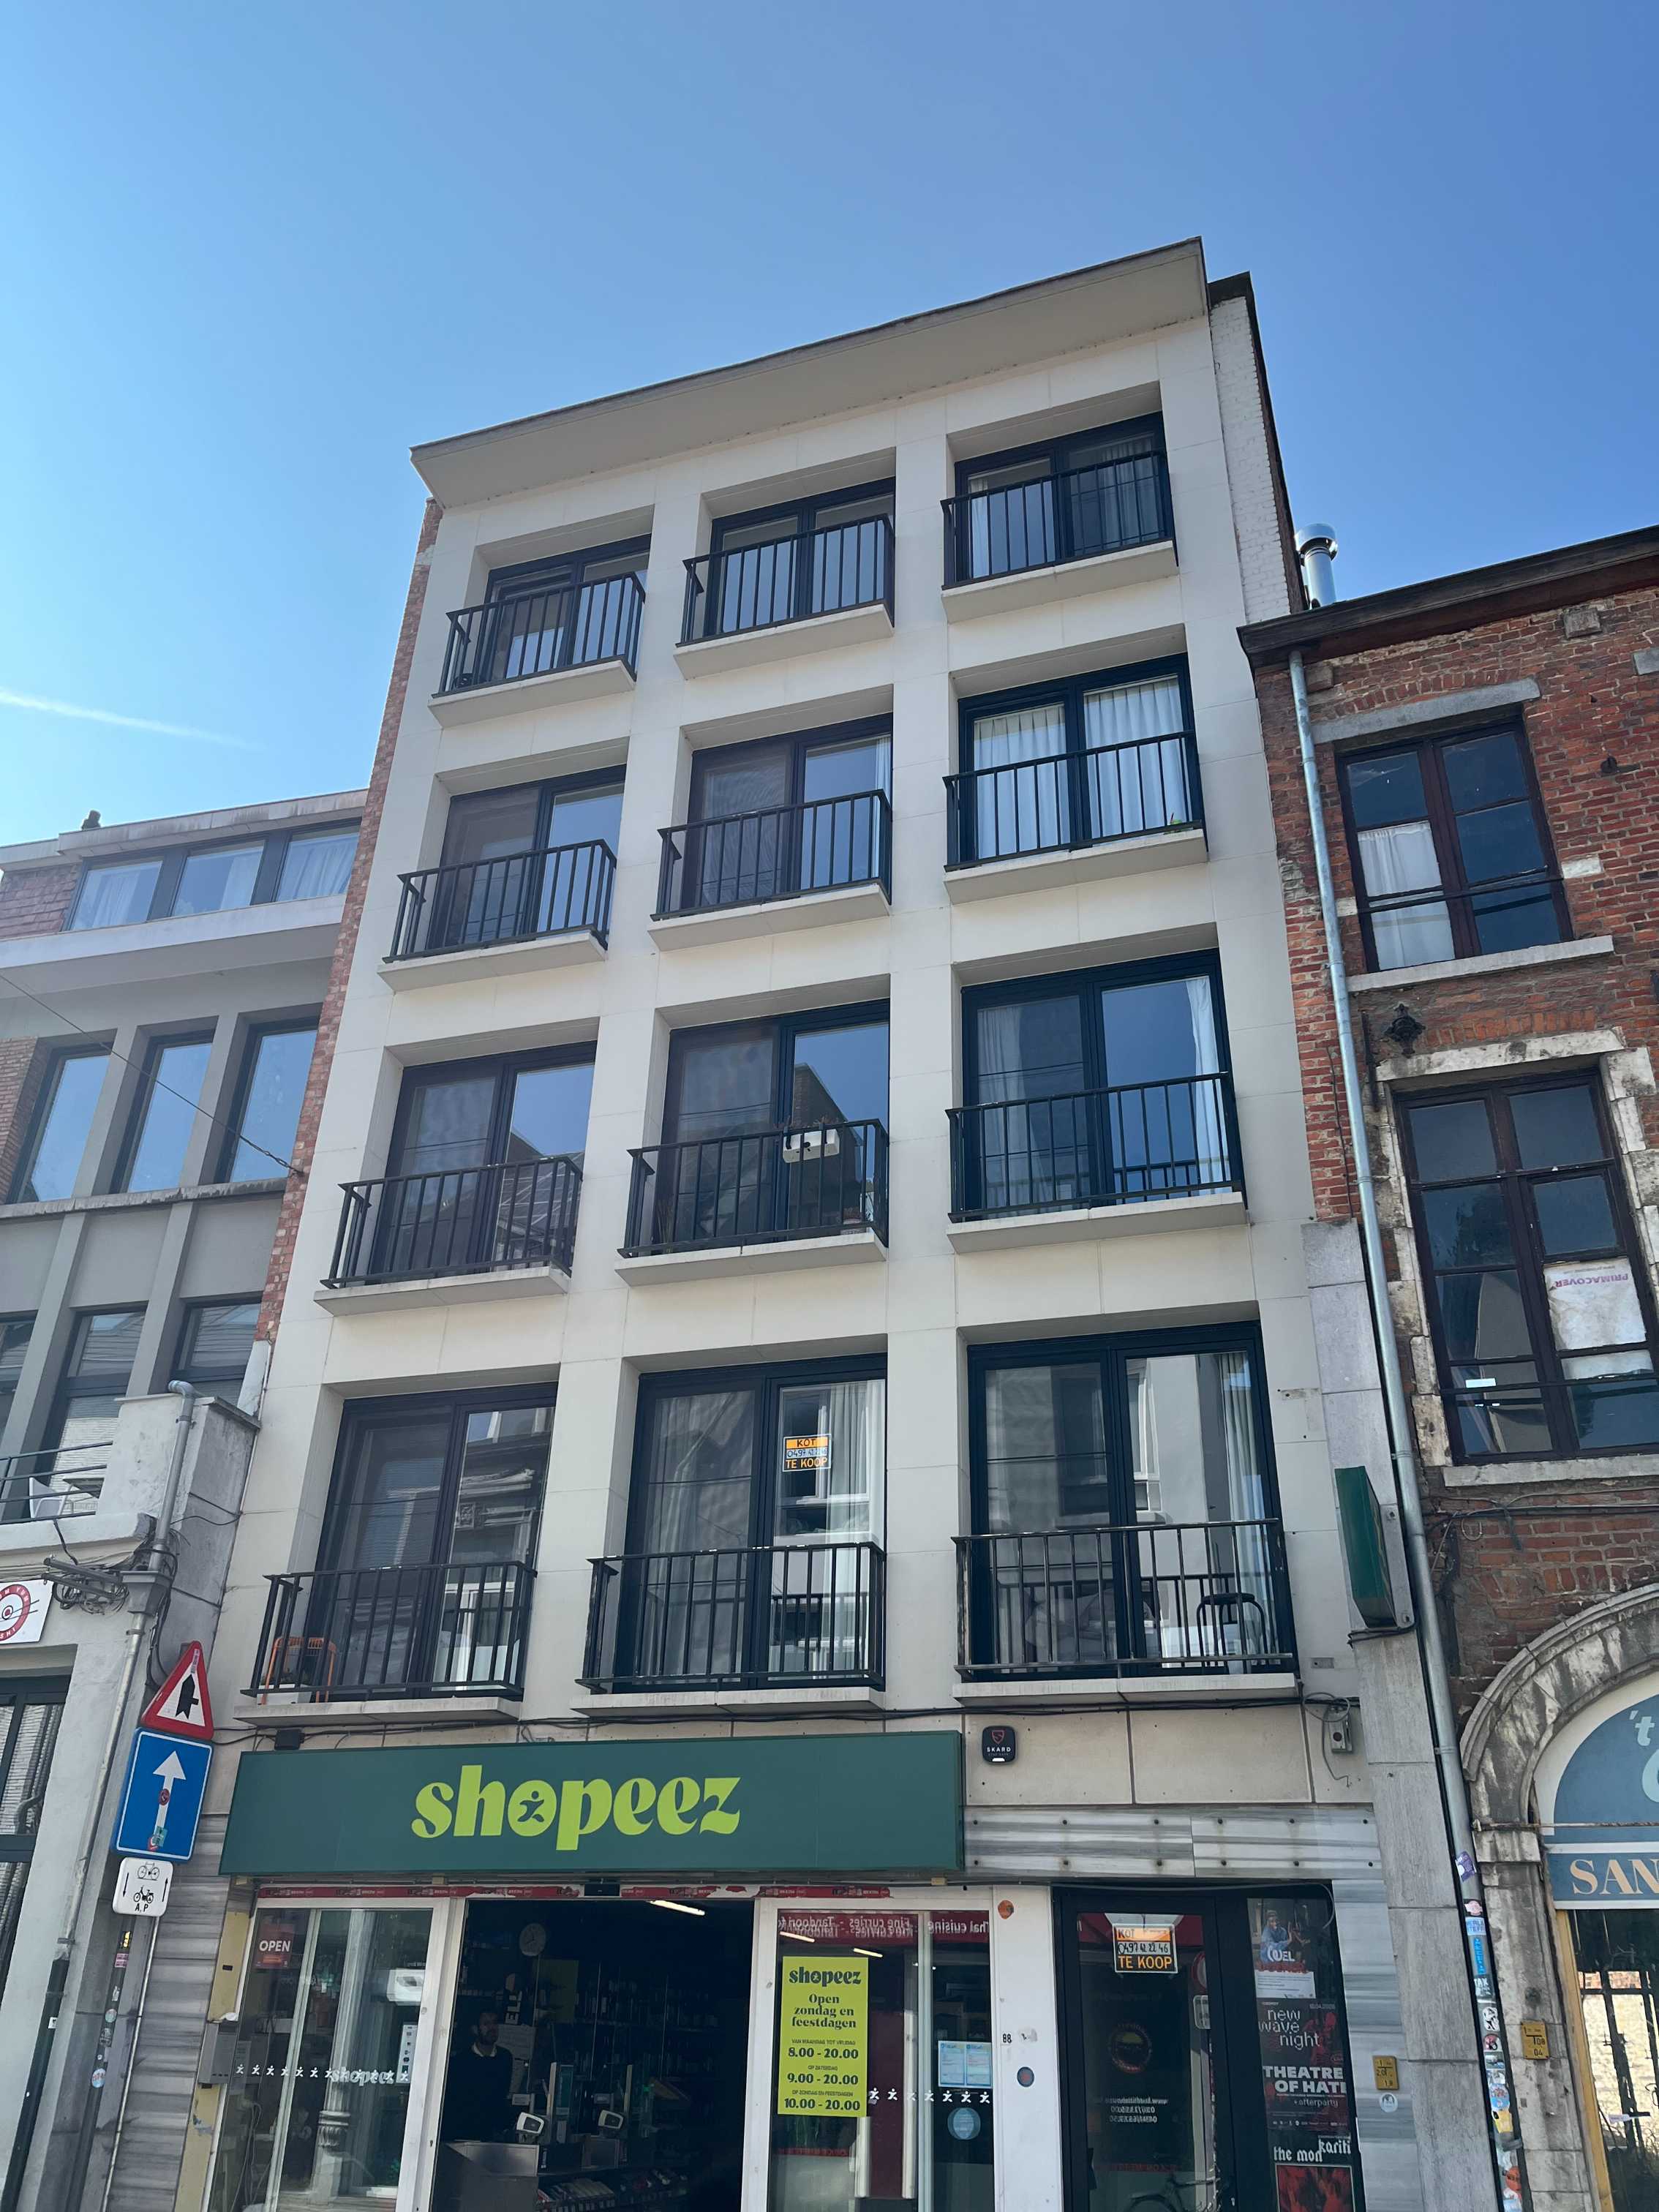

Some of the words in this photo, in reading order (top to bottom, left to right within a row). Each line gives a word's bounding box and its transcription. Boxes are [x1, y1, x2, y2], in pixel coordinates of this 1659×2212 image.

[797, 1438, 816, 1448] KOT
[786, 1459, 797, 1469] TE
[800, 1456, 828, 1468] KOOP
[1629, 1709, 1655, 1747] 't
[411, 1764, 742, 1851] shopeez
[1118, 1928, 1135, 1938] KOT
[259, 1940, 290, 1952] OPEN
[1158, 1943, 1168, 1953] 46
[1118, 1955, 1133, 1969] TE
[1137, 1956, 1172, 1969] KOOP
[789, 1966, 862, 1987] shopeez
[808, 1993, 840, 2006] Open
[794, 2004, 837, 2017] zondag
[839, 2007, 854, 2016] en
[1267, 2009, 1301, 2020] new
[791, 2016, 857, 2030] feestdagen
[1258, 2020, 1300, 2033] wave
[1002, 2033, 1012, 2044] 88
[1280, 2031, 1320, 2050] night
[789, 2047, 814, 2057] 8.00
[824, 2048, 859, 2059] 20.00
[331, 2066, 395, 2087] shopeez
[787, 2073, 813, 2083] 9.00
[823, 2074, 859, 2085] 20.00
[1262, 2066, 1344, 2080] THEATRE
[1274, 2080, 1299, 2093] OF
[784, 2098, 816, 2109] 10.00
[824, 2099, 860, 2111] 20.00
[1273, 2145, 1293, 2162] the
